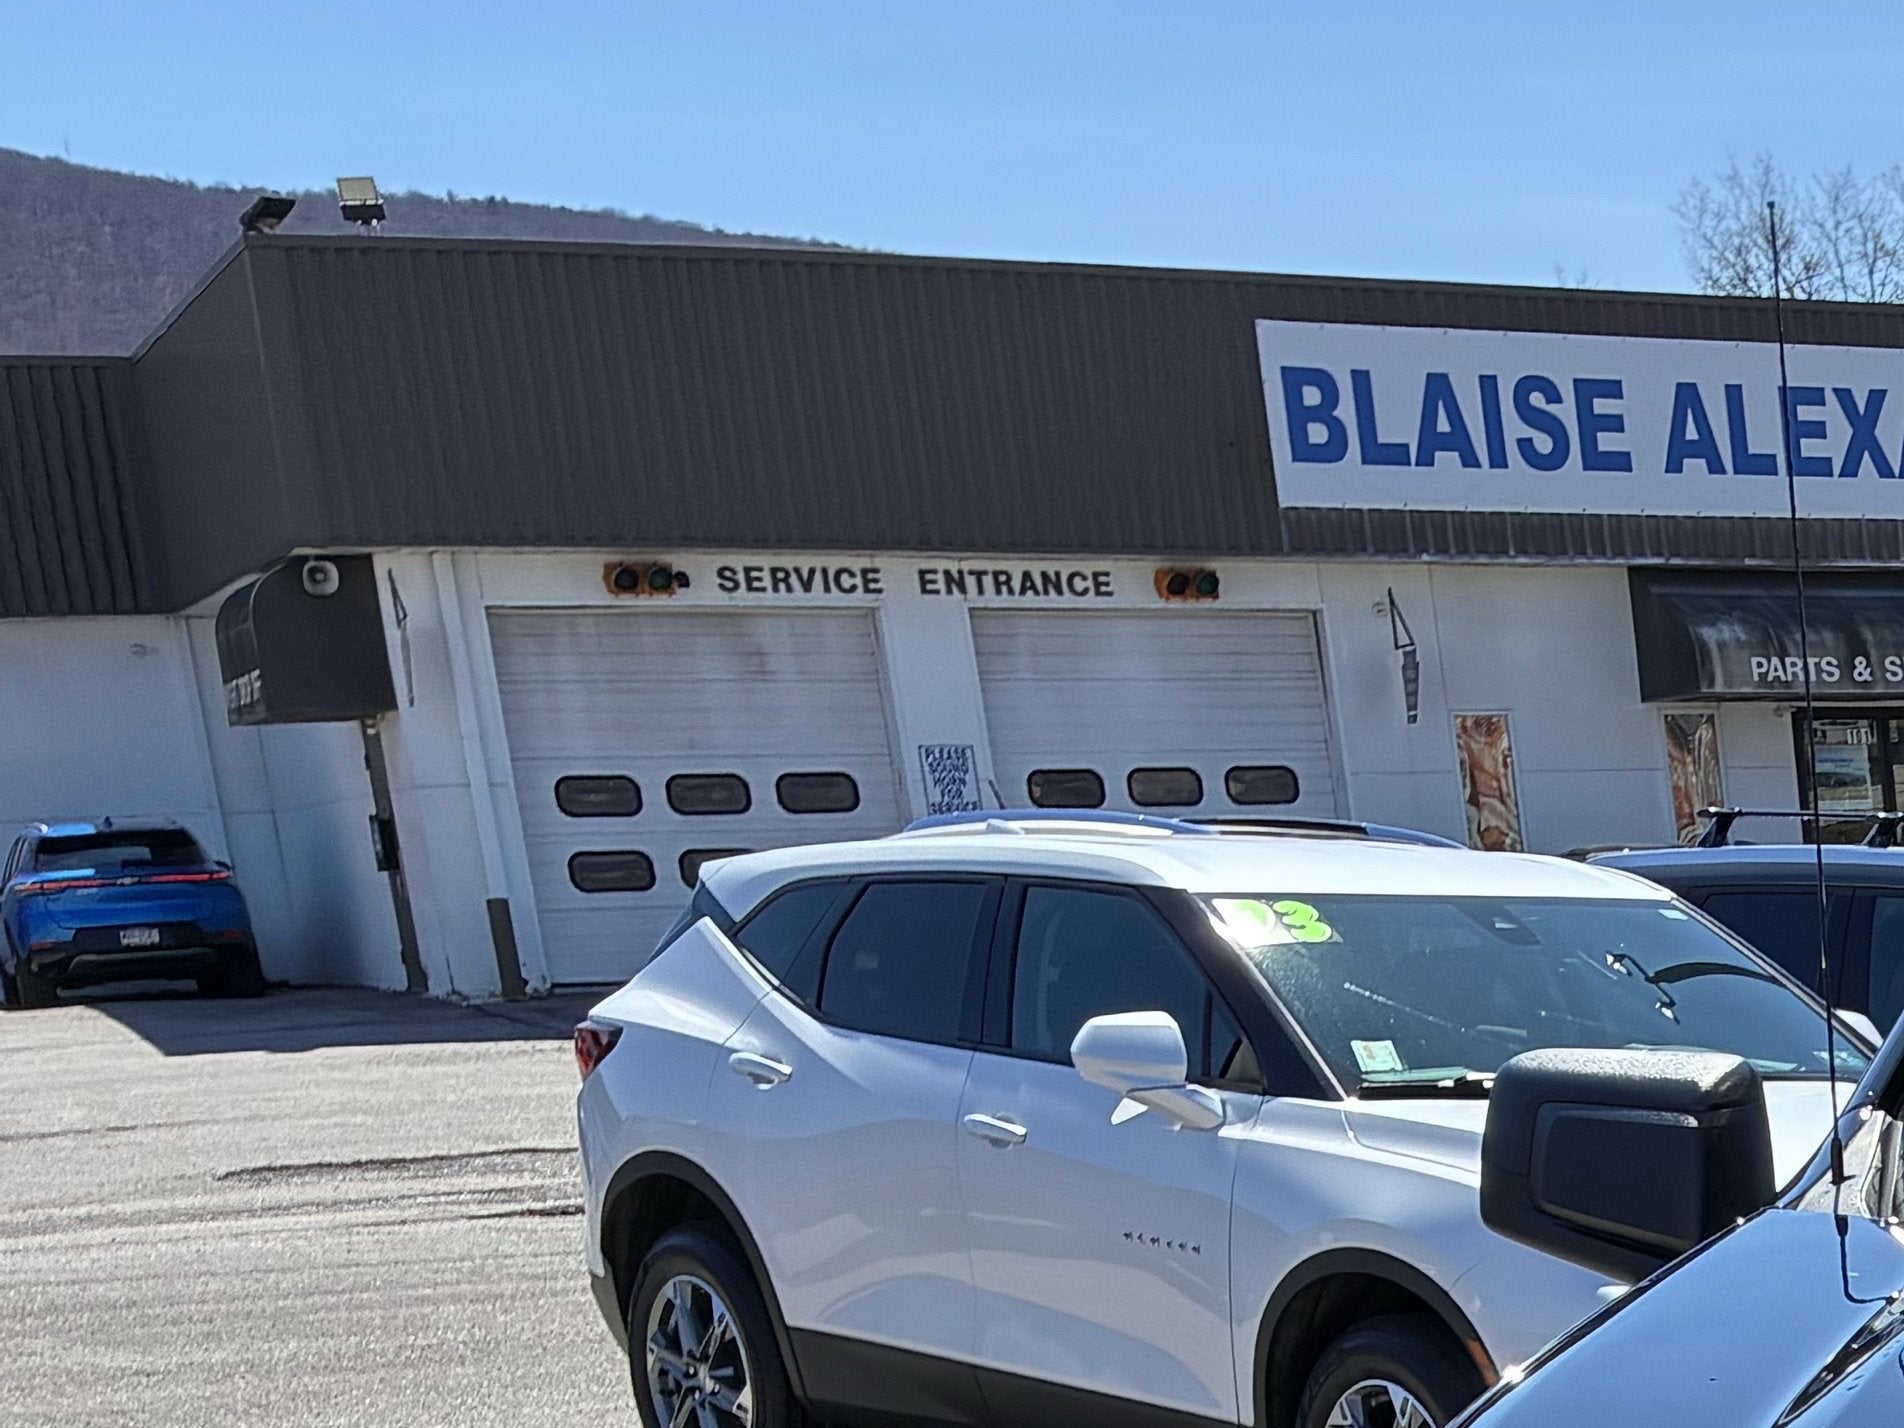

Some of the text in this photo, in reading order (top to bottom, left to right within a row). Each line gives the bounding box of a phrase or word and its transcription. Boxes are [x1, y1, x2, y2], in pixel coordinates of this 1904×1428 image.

[1279, 365, 1634, 475] BLAISE
[716, 565, 1115, 598] SERVICE ENTRANCE
[1750, 655, 1841, 683] PARTS
[1852, 655, 1874, 683] &
